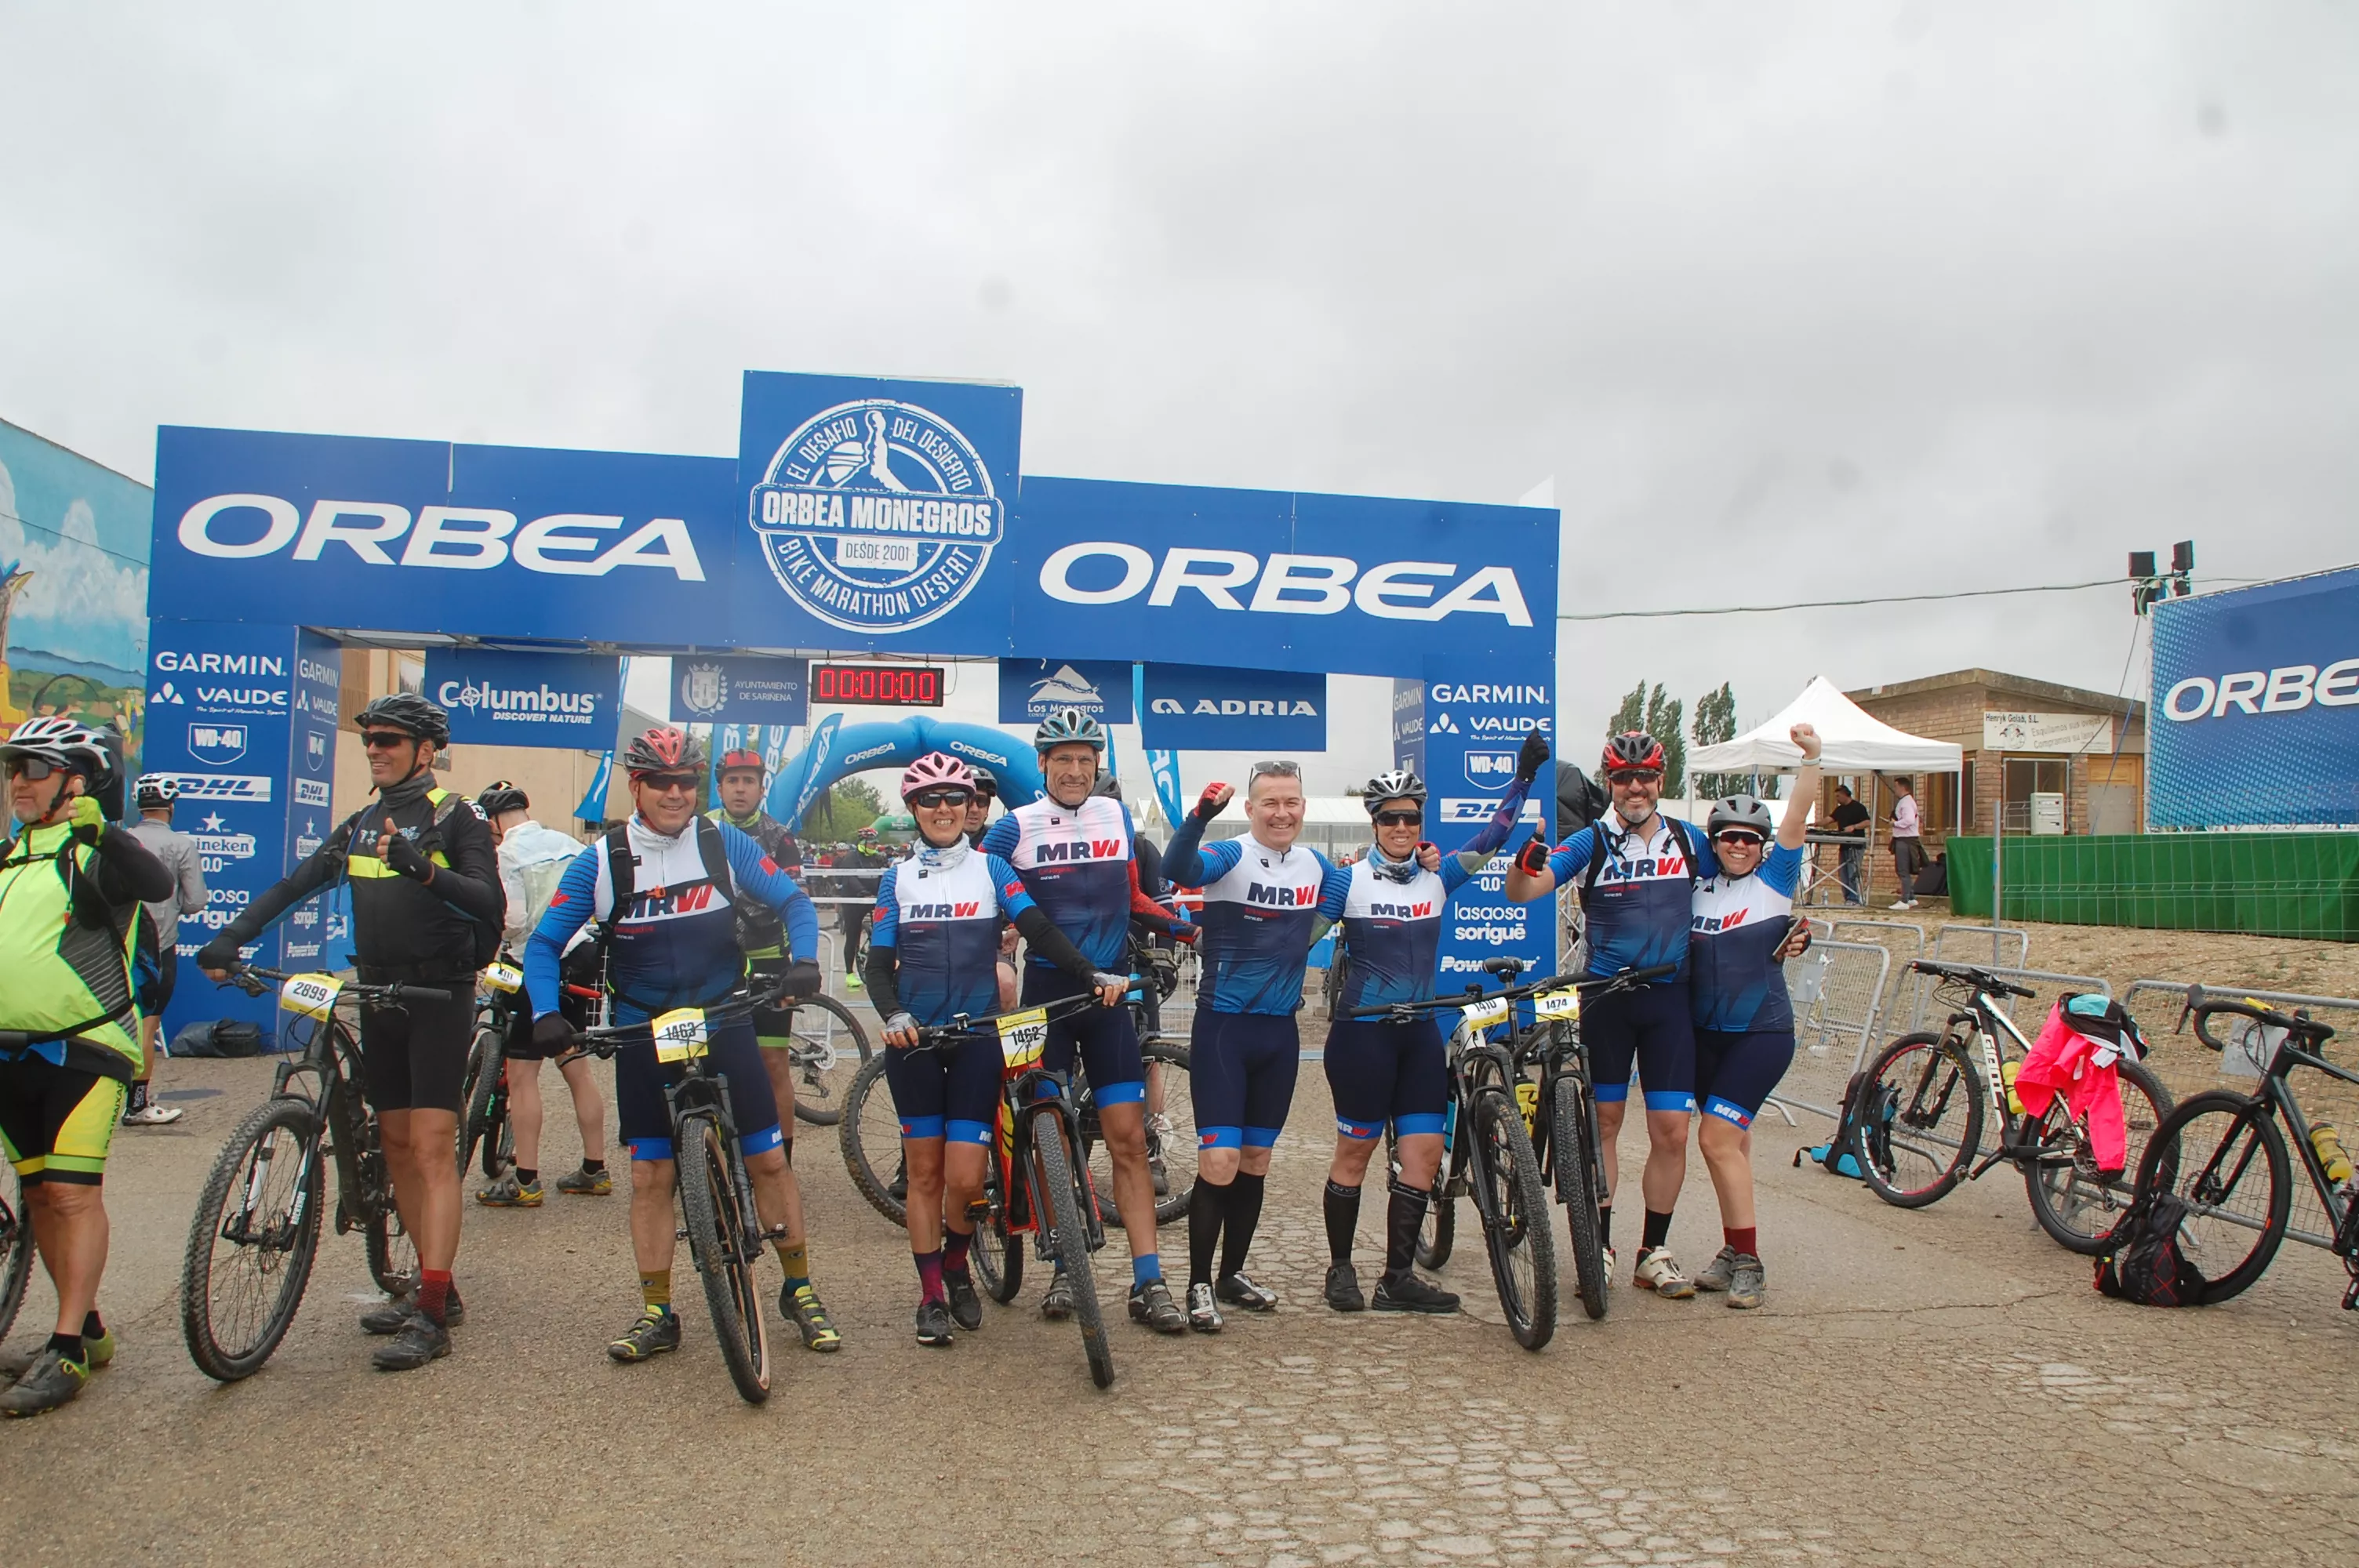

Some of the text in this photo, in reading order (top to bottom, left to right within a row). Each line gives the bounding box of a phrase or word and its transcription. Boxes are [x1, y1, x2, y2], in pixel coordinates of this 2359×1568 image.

[787, 416, 859, 482] EL DESAFIO
[892, 417, 973, 492] DEL DESIERTO
[762, 491, 992, 536] ORBEA MONEGROS
[178, 493, 707, 582] ORBEA
[845, 543, 910, 562] DESDE 2001
[777, 539, 975, 617] BIKE MARATHON DESERT
[1039, 542, 1534, 627] ORBEA
[155, 651, 283, 677] GARMIN
[300, 659, 339, 688] GARMIN
[734, 680, 798, 691] AYUNTAMIENTO
[1431, 684, 1545, 704] GARMIN
[198, 688, 288, 706] VAUDE
[313, 696, 337, 716] VAUDE
[438, 679, 595, 715] Columbus
[740, 692, 751, 701] DE
[1394, 687, 1422, 711] GARMIN
[493, 710, 592, 724] DISCOVER NATURE
[1028, 703, 1046, 713] Los
[1192, 699, 1318, 717] ADRIA
[1401, 717, 1423, 735] VAUDE
[1470, 717, 1551, 731] VAUDE
[845, 742, 896, 764] ORBEA
[951, 741, 1007, 767] ORBEA
[176, 778, 256, 797] DHL
[197, 838, 249, 852] ineken
[1037, 839, 1120, 863] MRW
[1603, 857, 1685, 881] MRW
[1247, 882, 1316, 906] MRW
[910, 902, 979, 918] MRW
[1371, 901, 1432, 918] MRW
[1455, 902, 1526, 920] lasaosa
[293, 982, 328, 1002] 2899
[1546, 999, 1568, 1010] 1474
[666, 1022, 696, 1040] 1463
[1012, 1026, 1040, 1045] 1462
